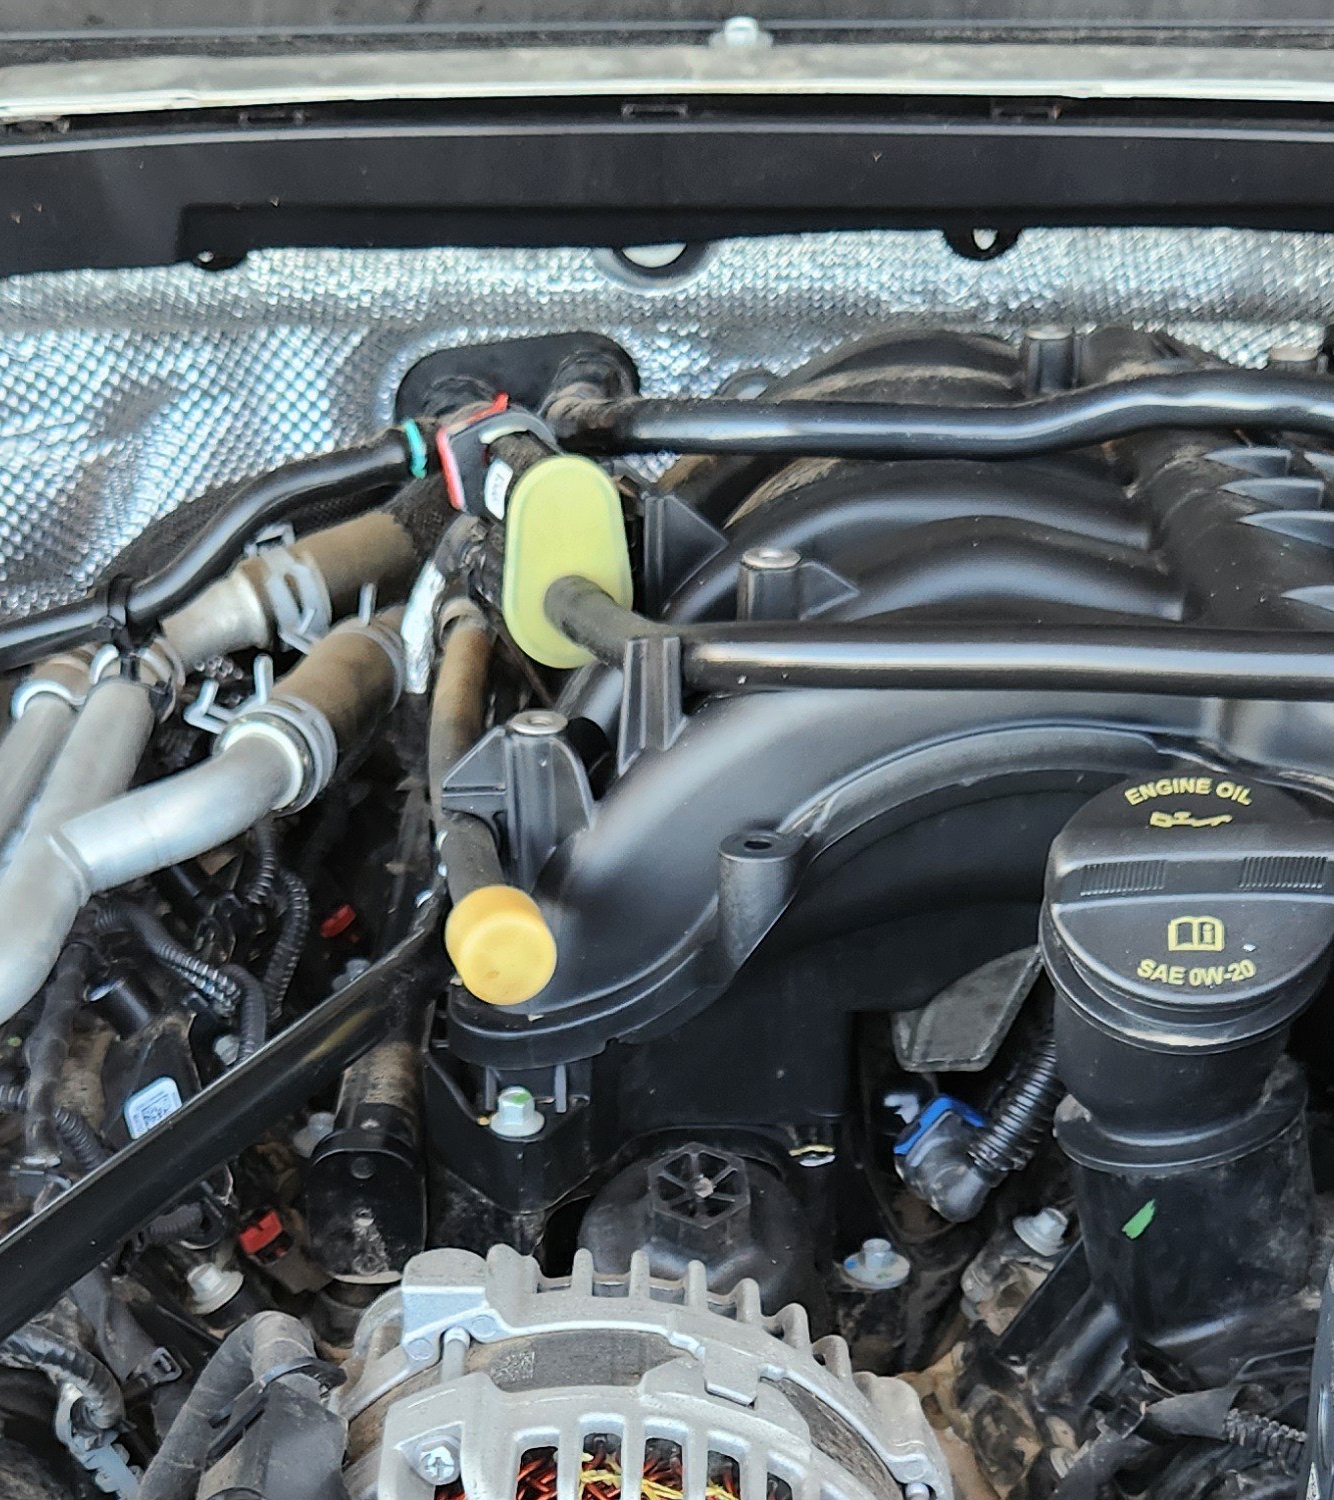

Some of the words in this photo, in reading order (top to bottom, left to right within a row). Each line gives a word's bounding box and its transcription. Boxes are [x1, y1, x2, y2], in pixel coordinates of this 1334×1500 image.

[1125, 777, 1212, 806] ENGINE
[1216, 781, 1254, 806] OIL
[1137, 959, 1186, 986] SAE
[1189, 959, 1256, 987] 0W-20
